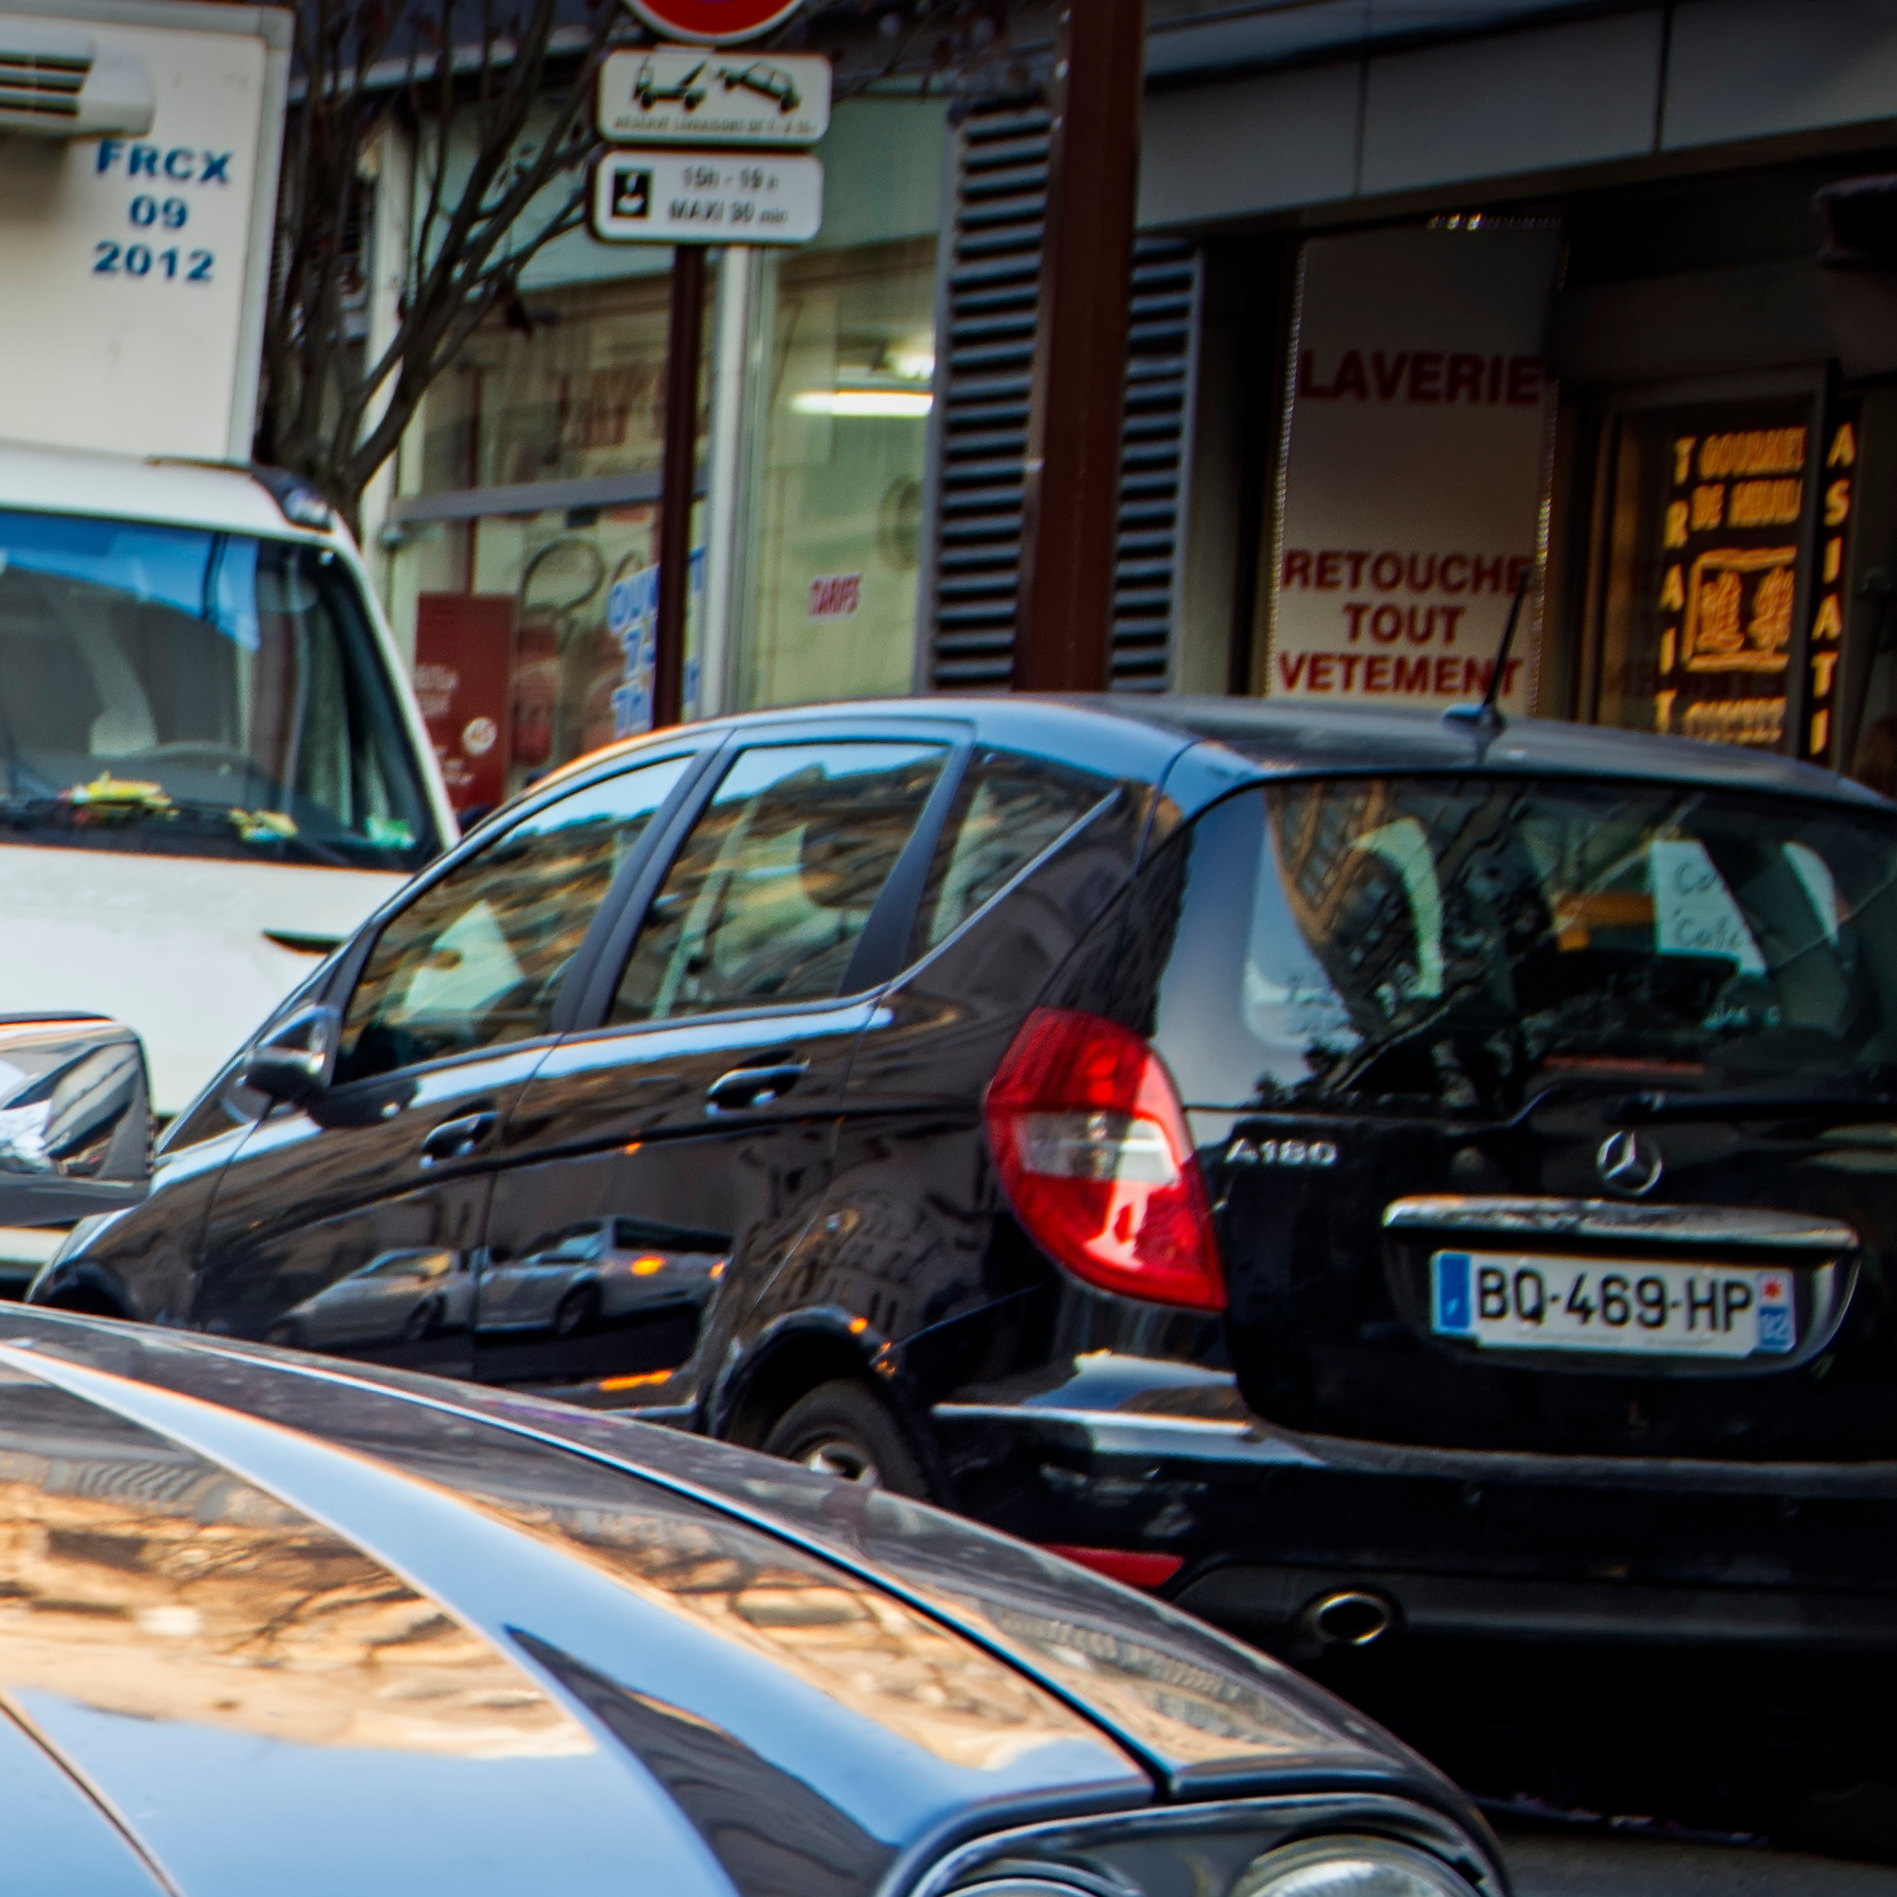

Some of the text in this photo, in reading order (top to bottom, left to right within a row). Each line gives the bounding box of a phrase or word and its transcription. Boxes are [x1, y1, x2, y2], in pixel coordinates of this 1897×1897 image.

[95, 138, 233, 185] FRCX
[129, 194, 189, 230] 09
[669, 199, 724, 222] MAXI
[759, 209, 789, 224] min
[93, 238, 215, 282] 2012
[1299, 350, 1542, 405] LAVERIE
[1279, 550, 1537, 595] RETOUCHE
[1342, 602, 1466, 647] TOUT
[1279, 652, 1524, 697] VETEMENT
[1477, 1266, 1753, 1334] BQ-469-HP
